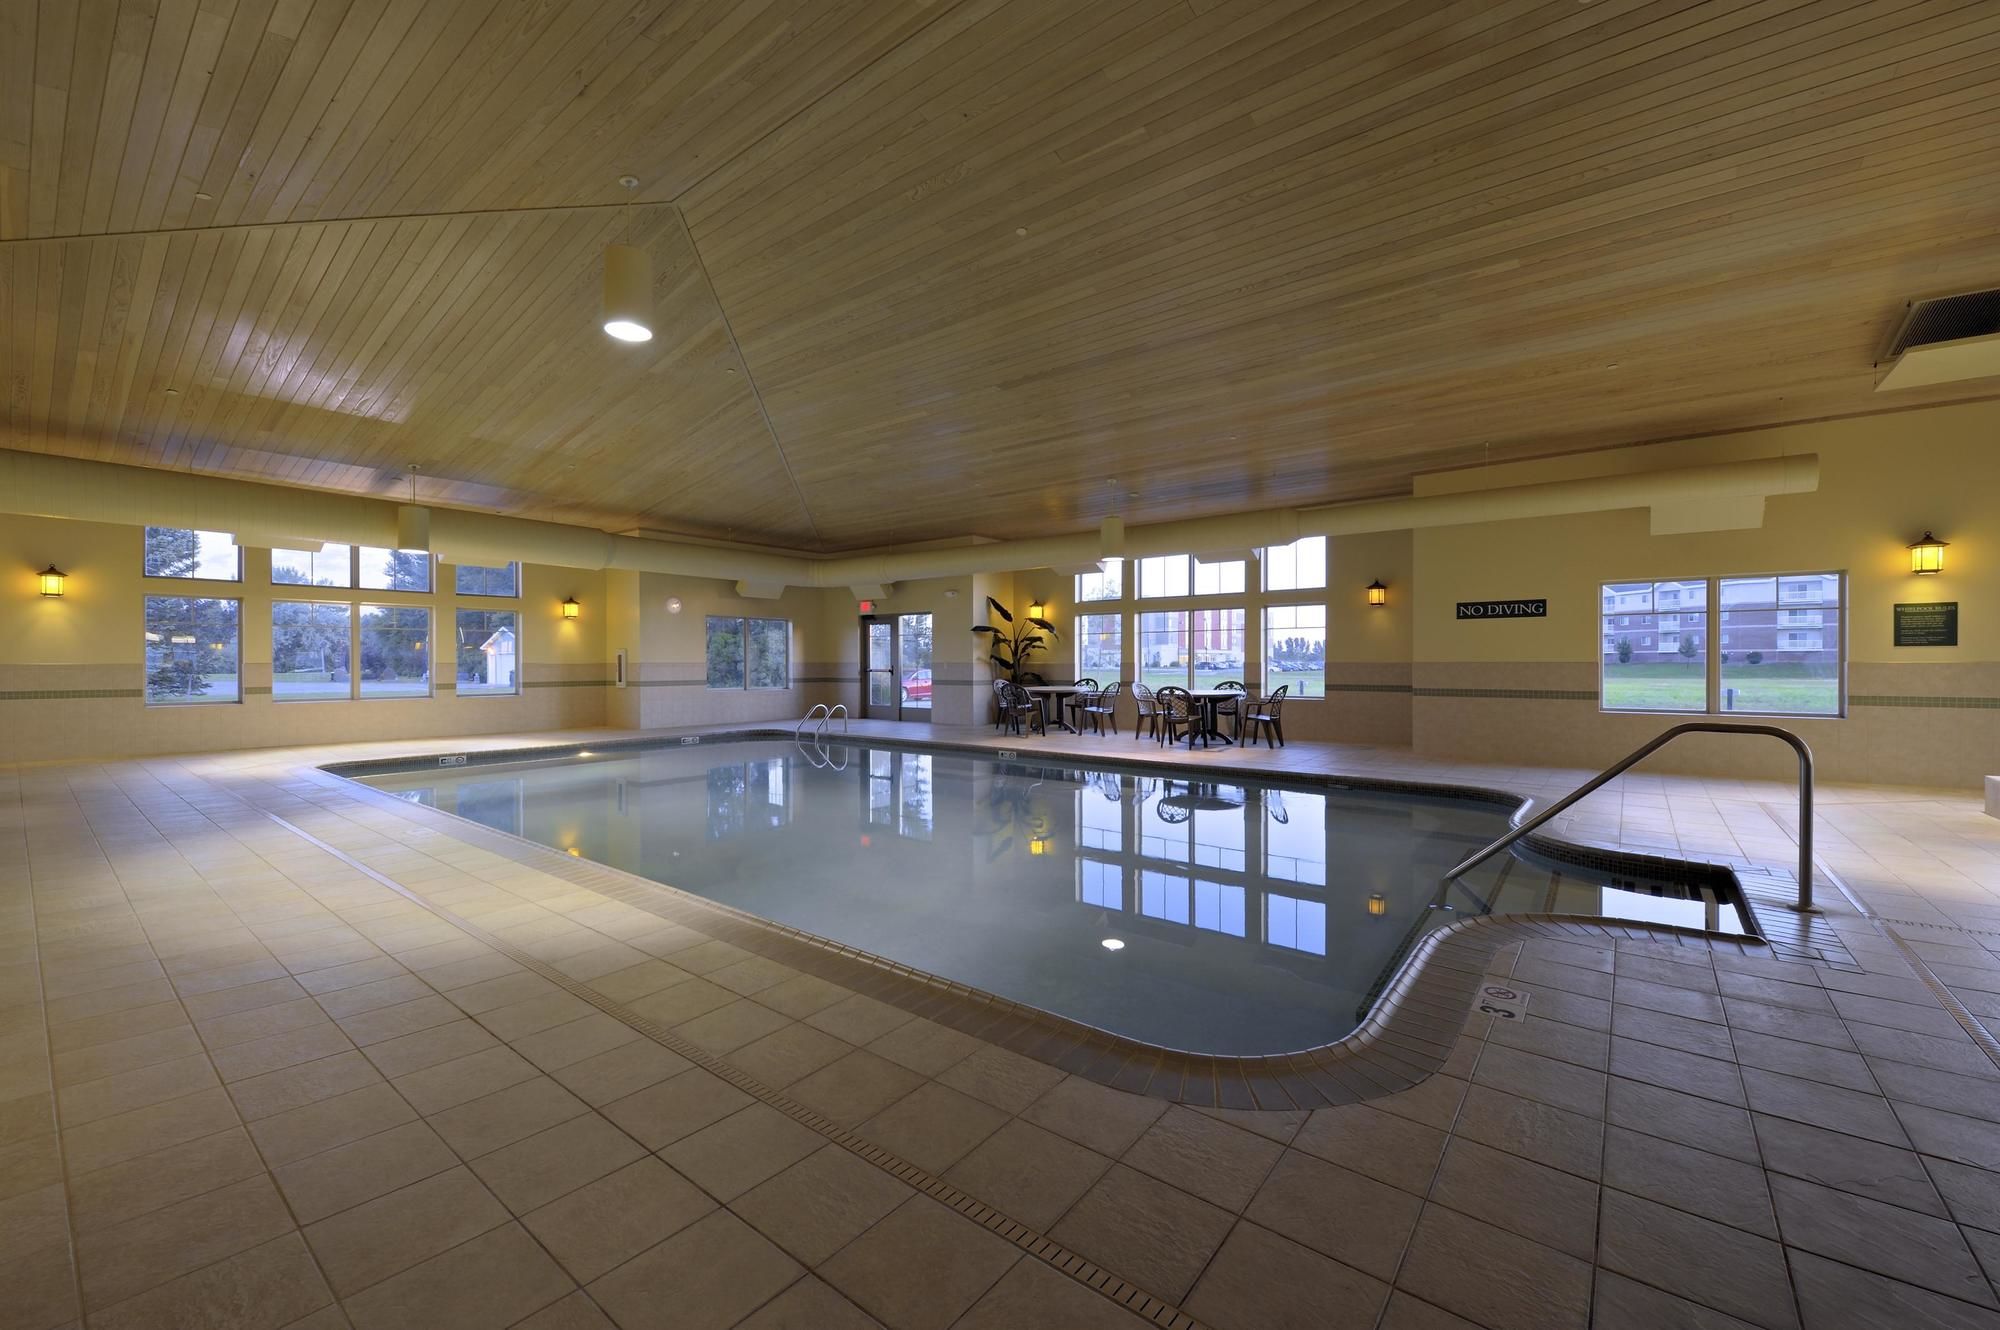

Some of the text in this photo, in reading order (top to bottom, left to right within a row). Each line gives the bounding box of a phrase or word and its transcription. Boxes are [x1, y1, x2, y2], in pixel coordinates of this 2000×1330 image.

[1459, 602, 1544, 617] NO DIVING
[1479, 1005, 1516, 1019] 3
